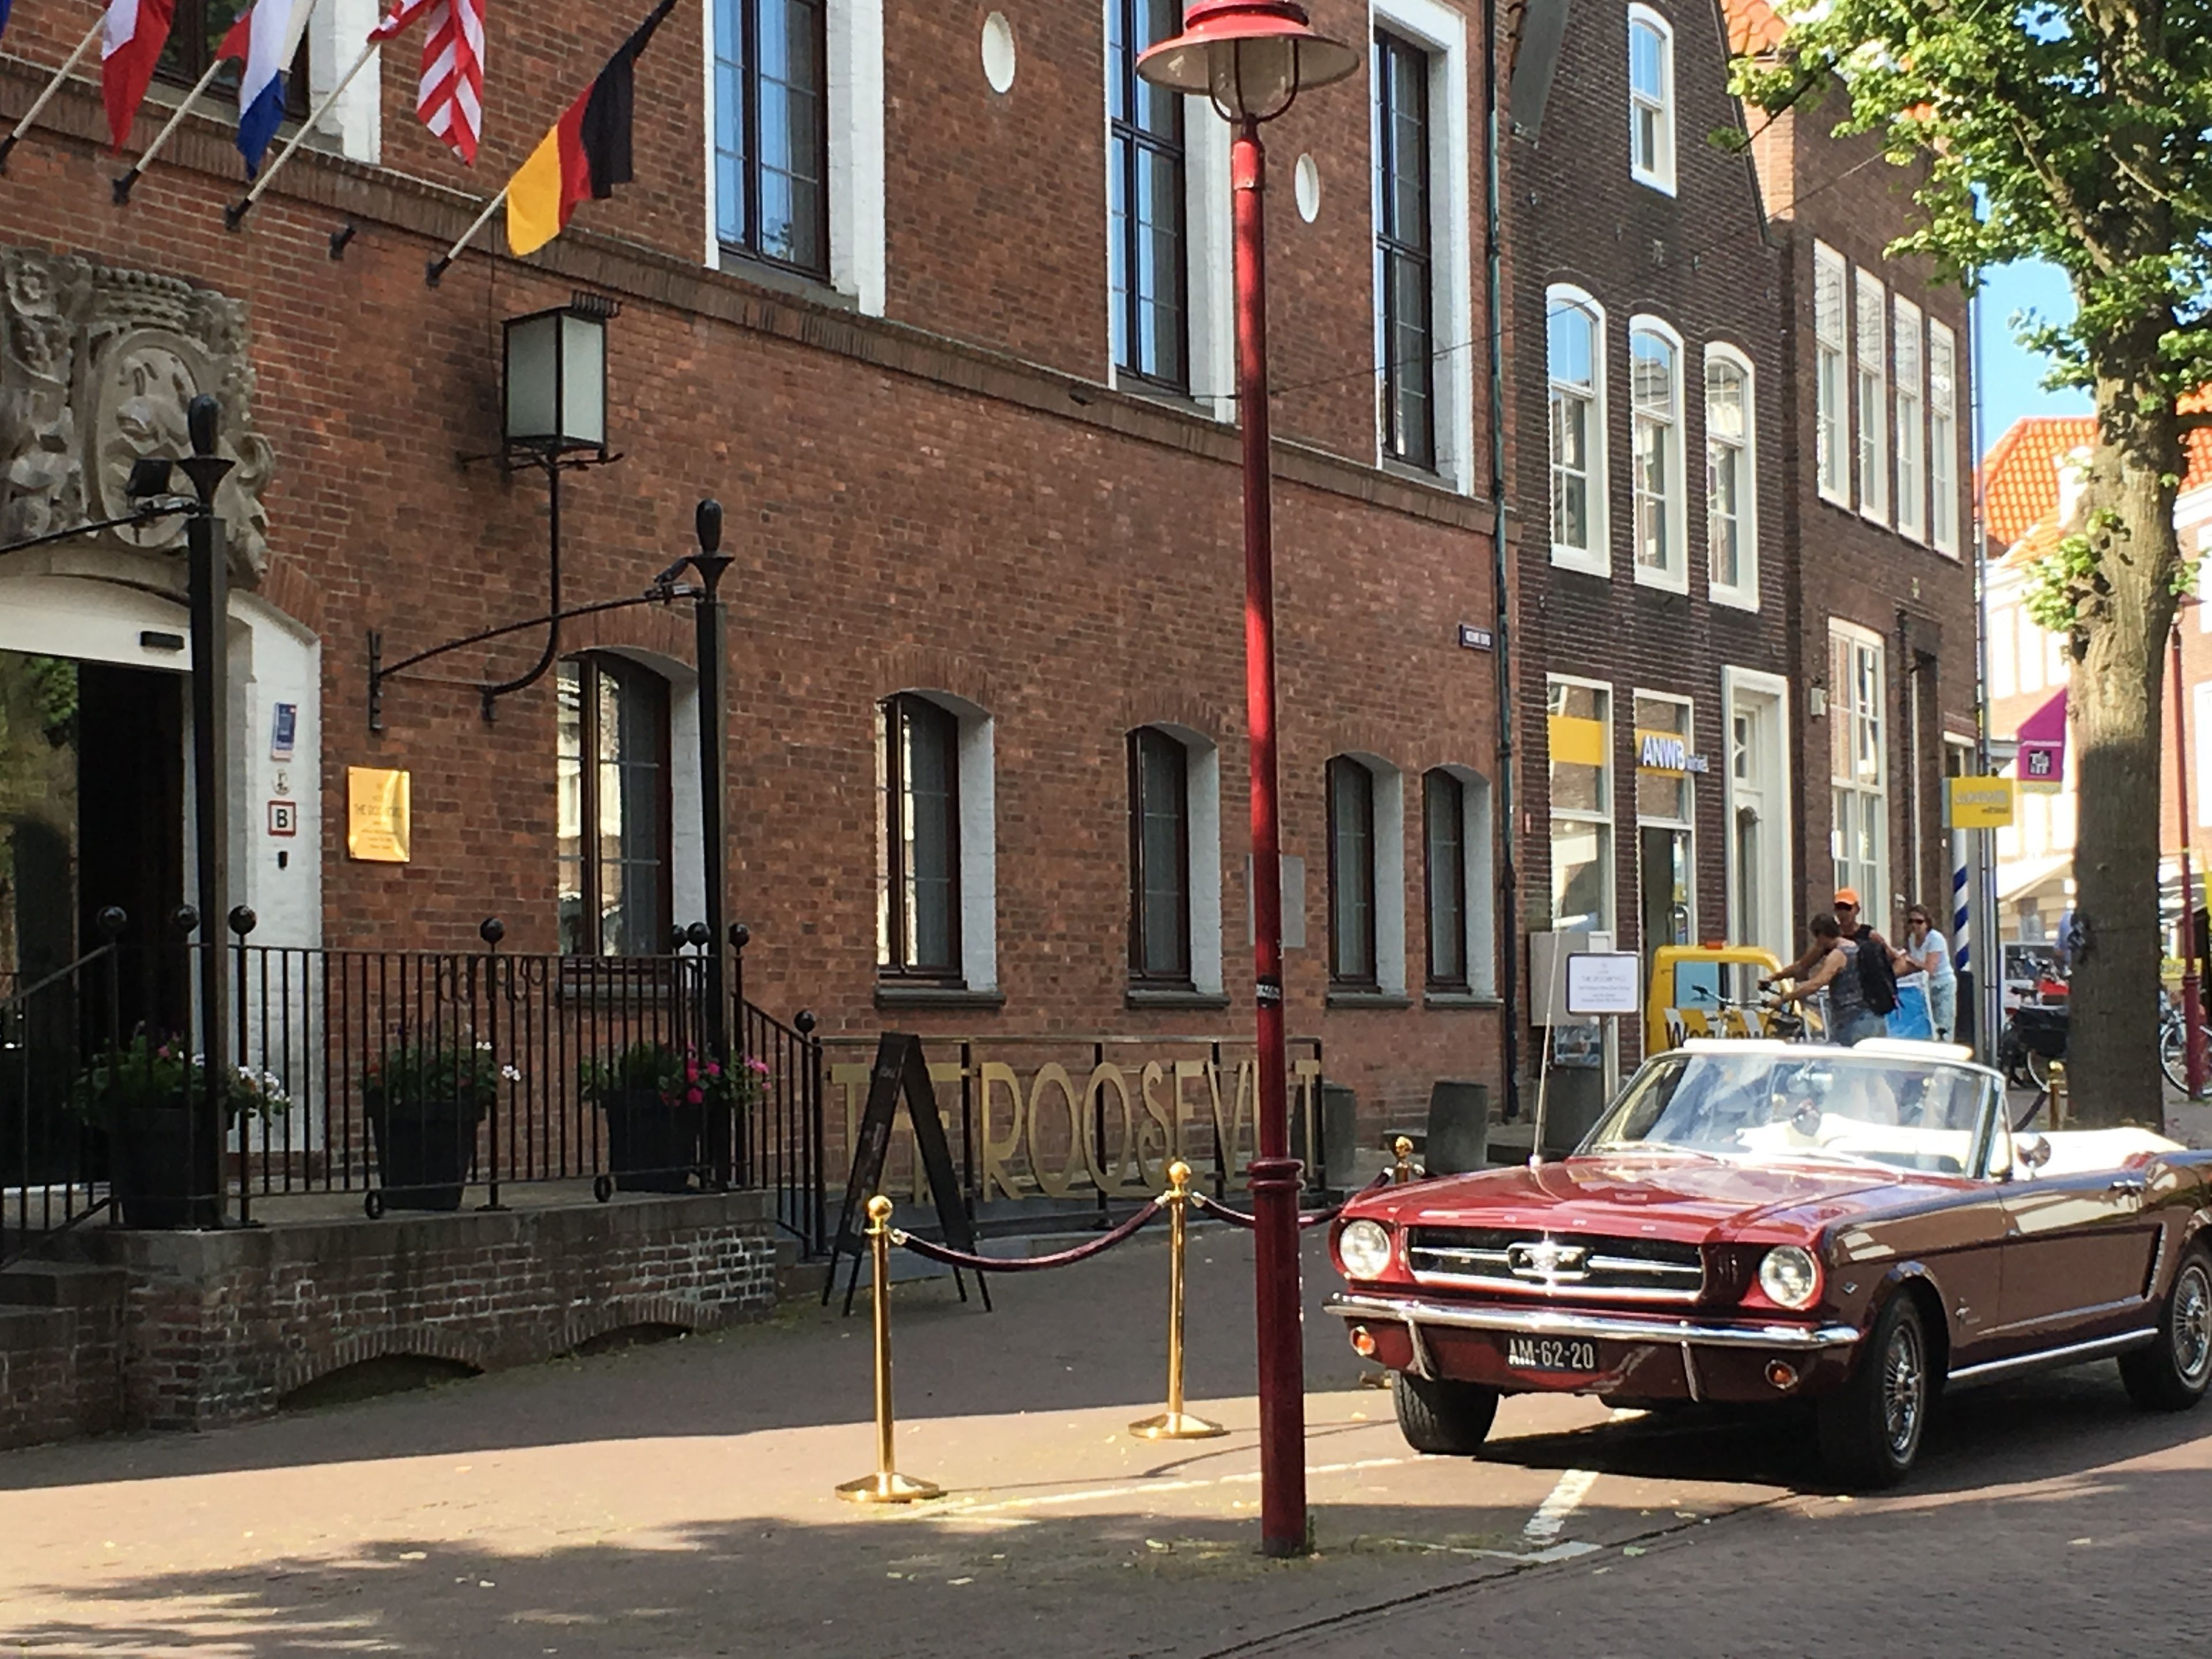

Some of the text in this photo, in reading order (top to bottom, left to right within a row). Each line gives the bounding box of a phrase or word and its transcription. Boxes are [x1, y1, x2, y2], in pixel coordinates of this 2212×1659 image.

[1642, 734, 1685, 771] ANWB
[276, 808, 289, 828] B
[981, 1060, 1320, 1202] ROOSEVT
[1509, 1338, 1595, 1369] AM-62-20
